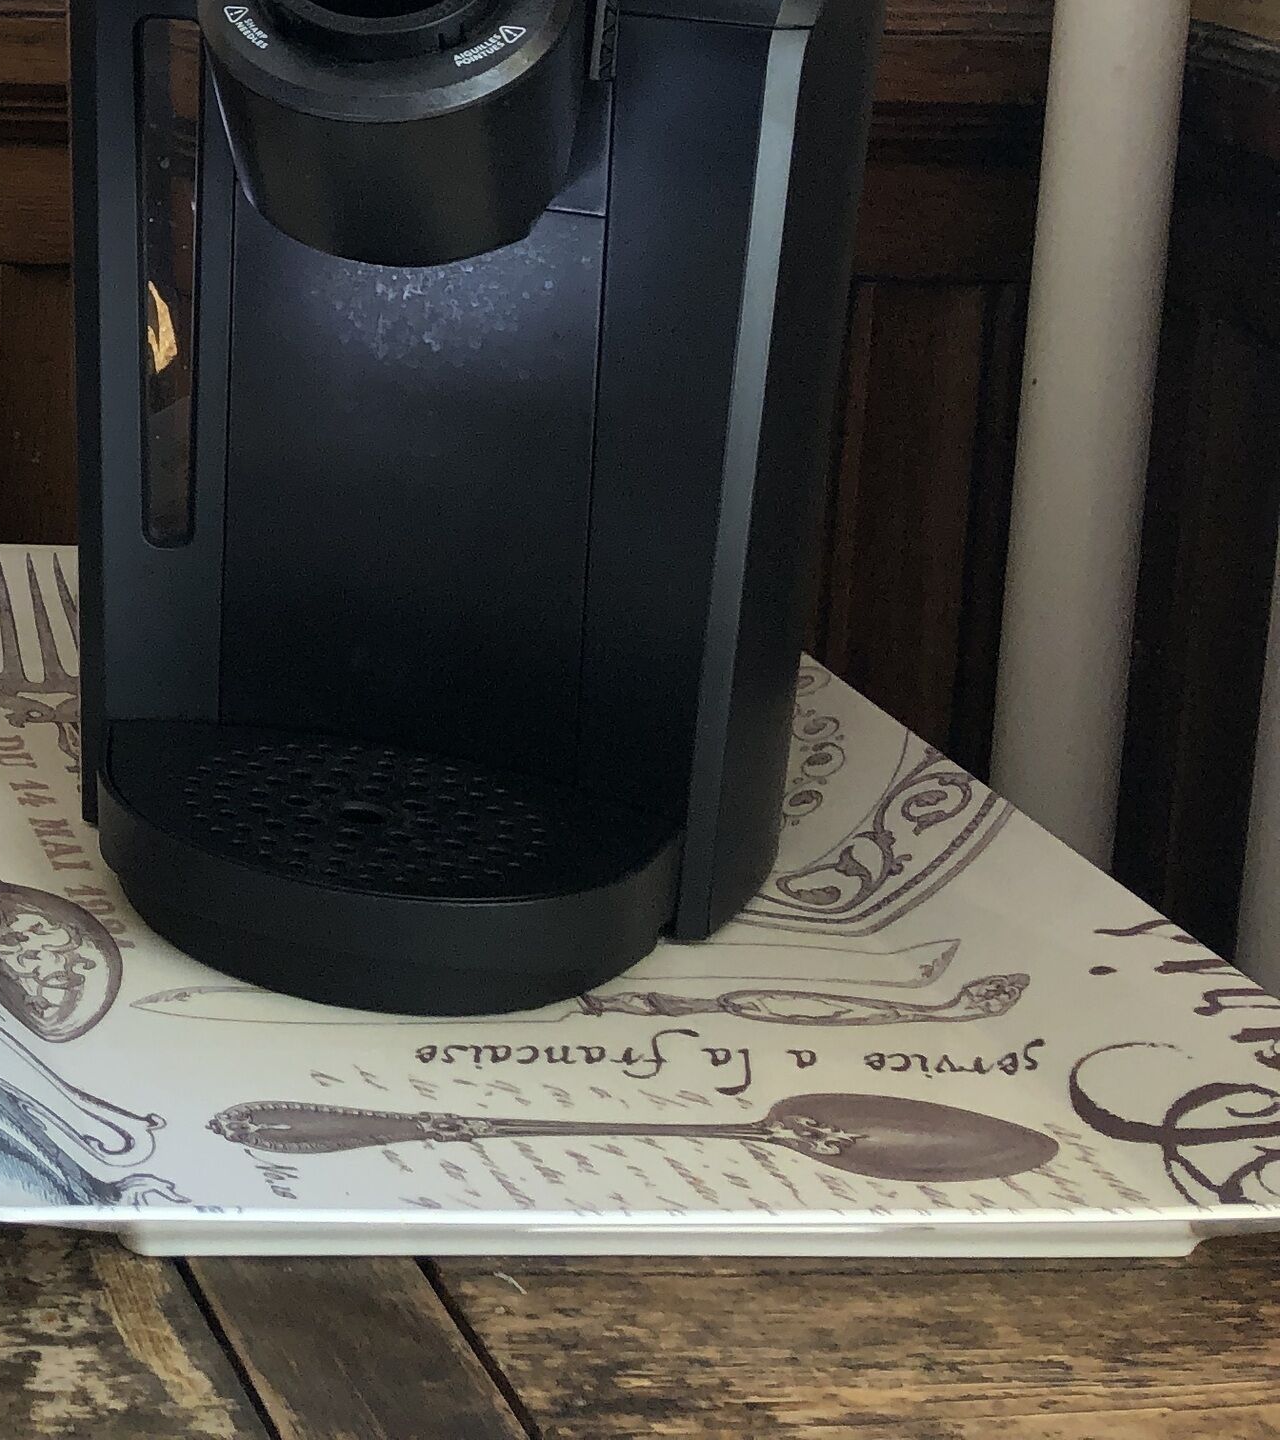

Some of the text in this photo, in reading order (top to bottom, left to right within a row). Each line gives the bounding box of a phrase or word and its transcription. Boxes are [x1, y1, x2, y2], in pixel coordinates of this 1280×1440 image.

[236, 21, 269, 49] NEEDLES
[244, 18, 268, 39] SHARP
[453, 33, 502, 62] AIGUILLES
[455, 41, 505, 67] POINTUES
[9, 780, 57, 808] 14
[28, 817, 96, 872] MAI
[415, 1029, 700, 1079] francaise
[786, 1048, 818, 1068] a
[865, 1039, 1046, 1078] service
[701, 1046, 752, 1096] la
